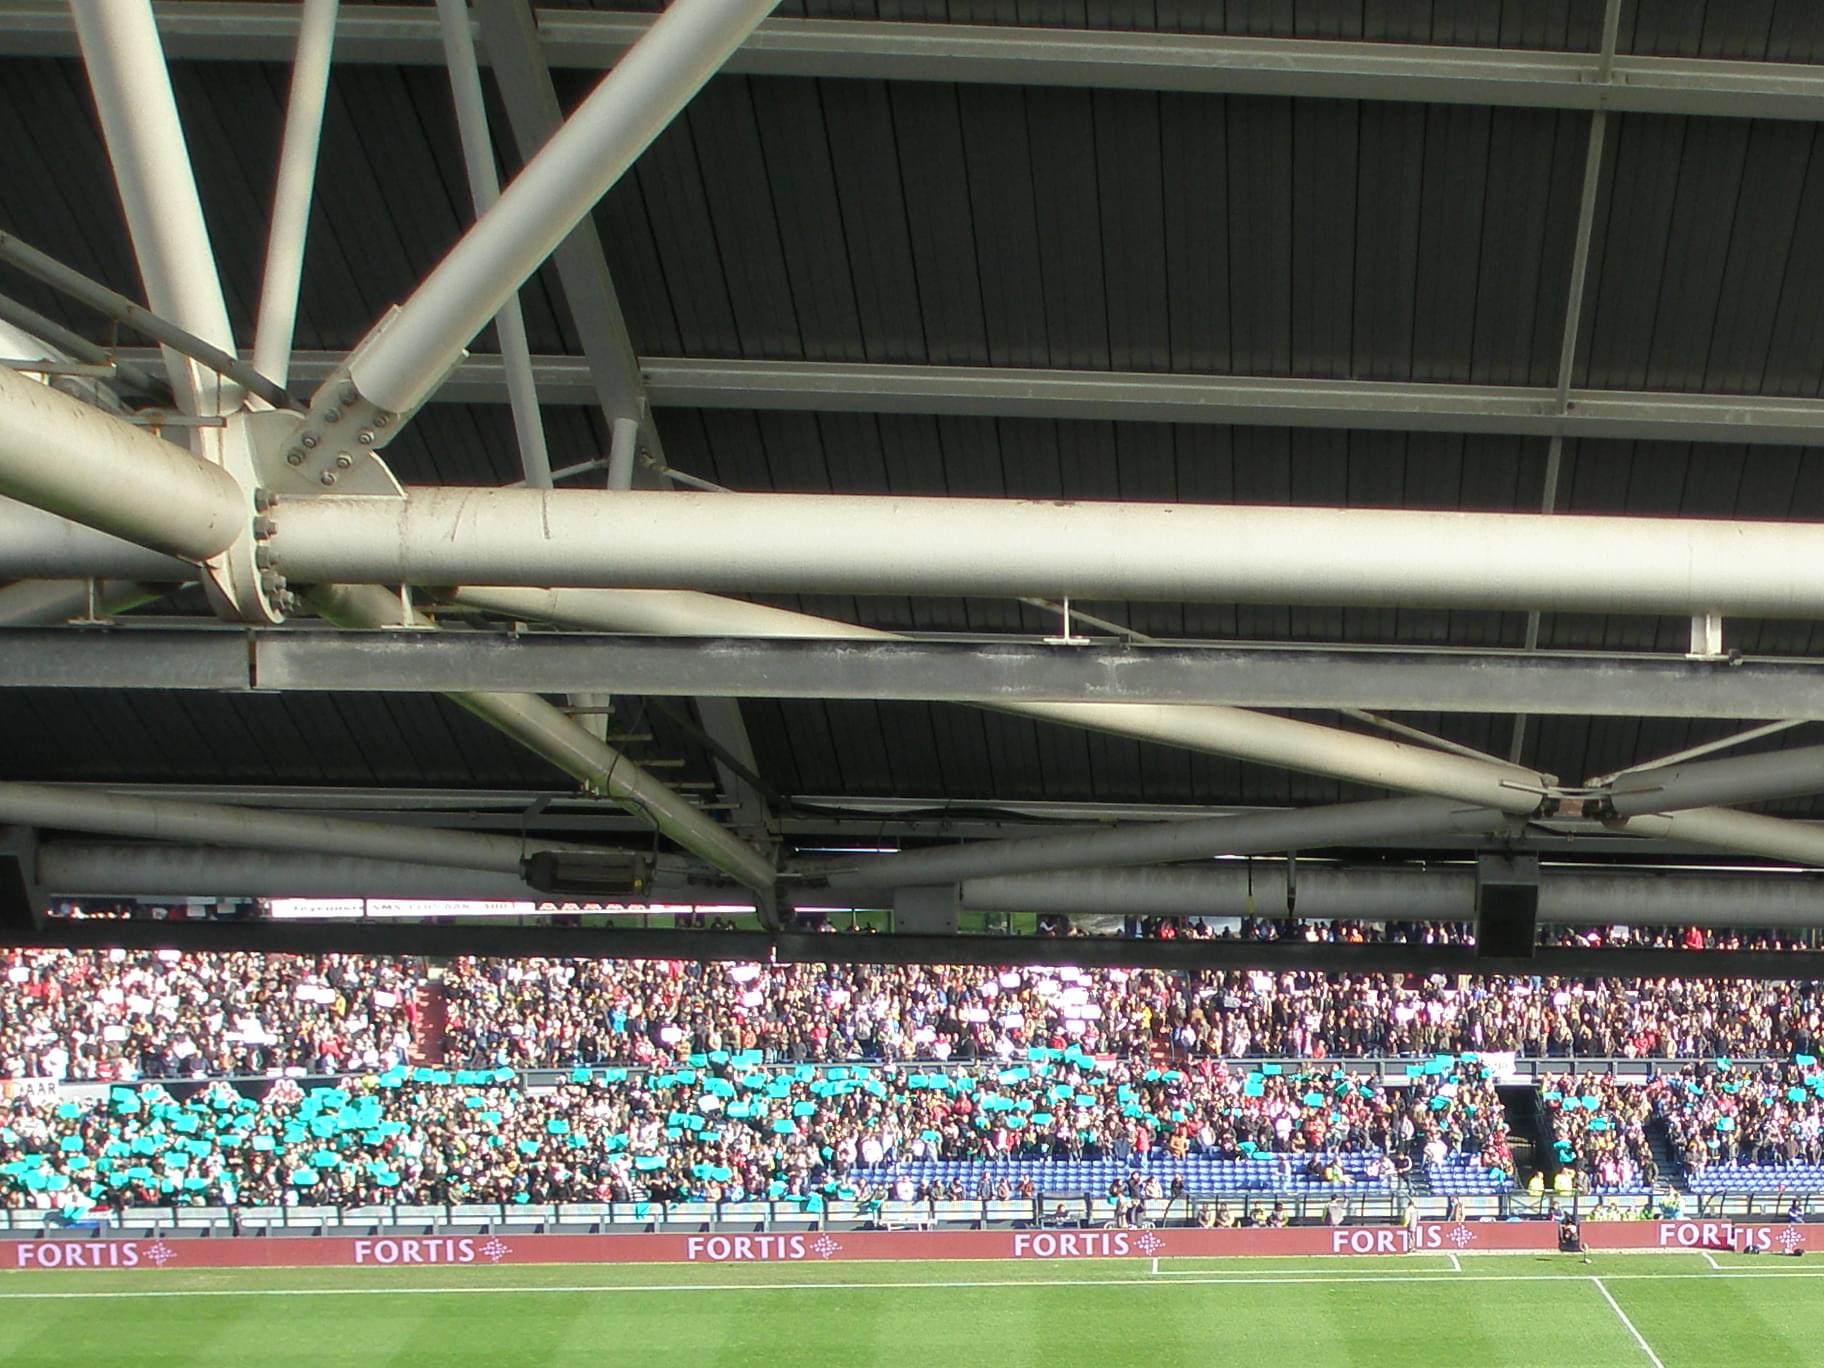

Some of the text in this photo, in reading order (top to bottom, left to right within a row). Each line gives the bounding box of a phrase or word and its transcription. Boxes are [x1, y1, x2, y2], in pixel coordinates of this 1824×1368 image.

[17, 1243, 139, 1267] FORTIS
[354, 1239, 475, 1263] FORTIS
[686, 1236, 806, 1260] FORTIS
[1013, 1233, 1129, 1256] FORTIS
